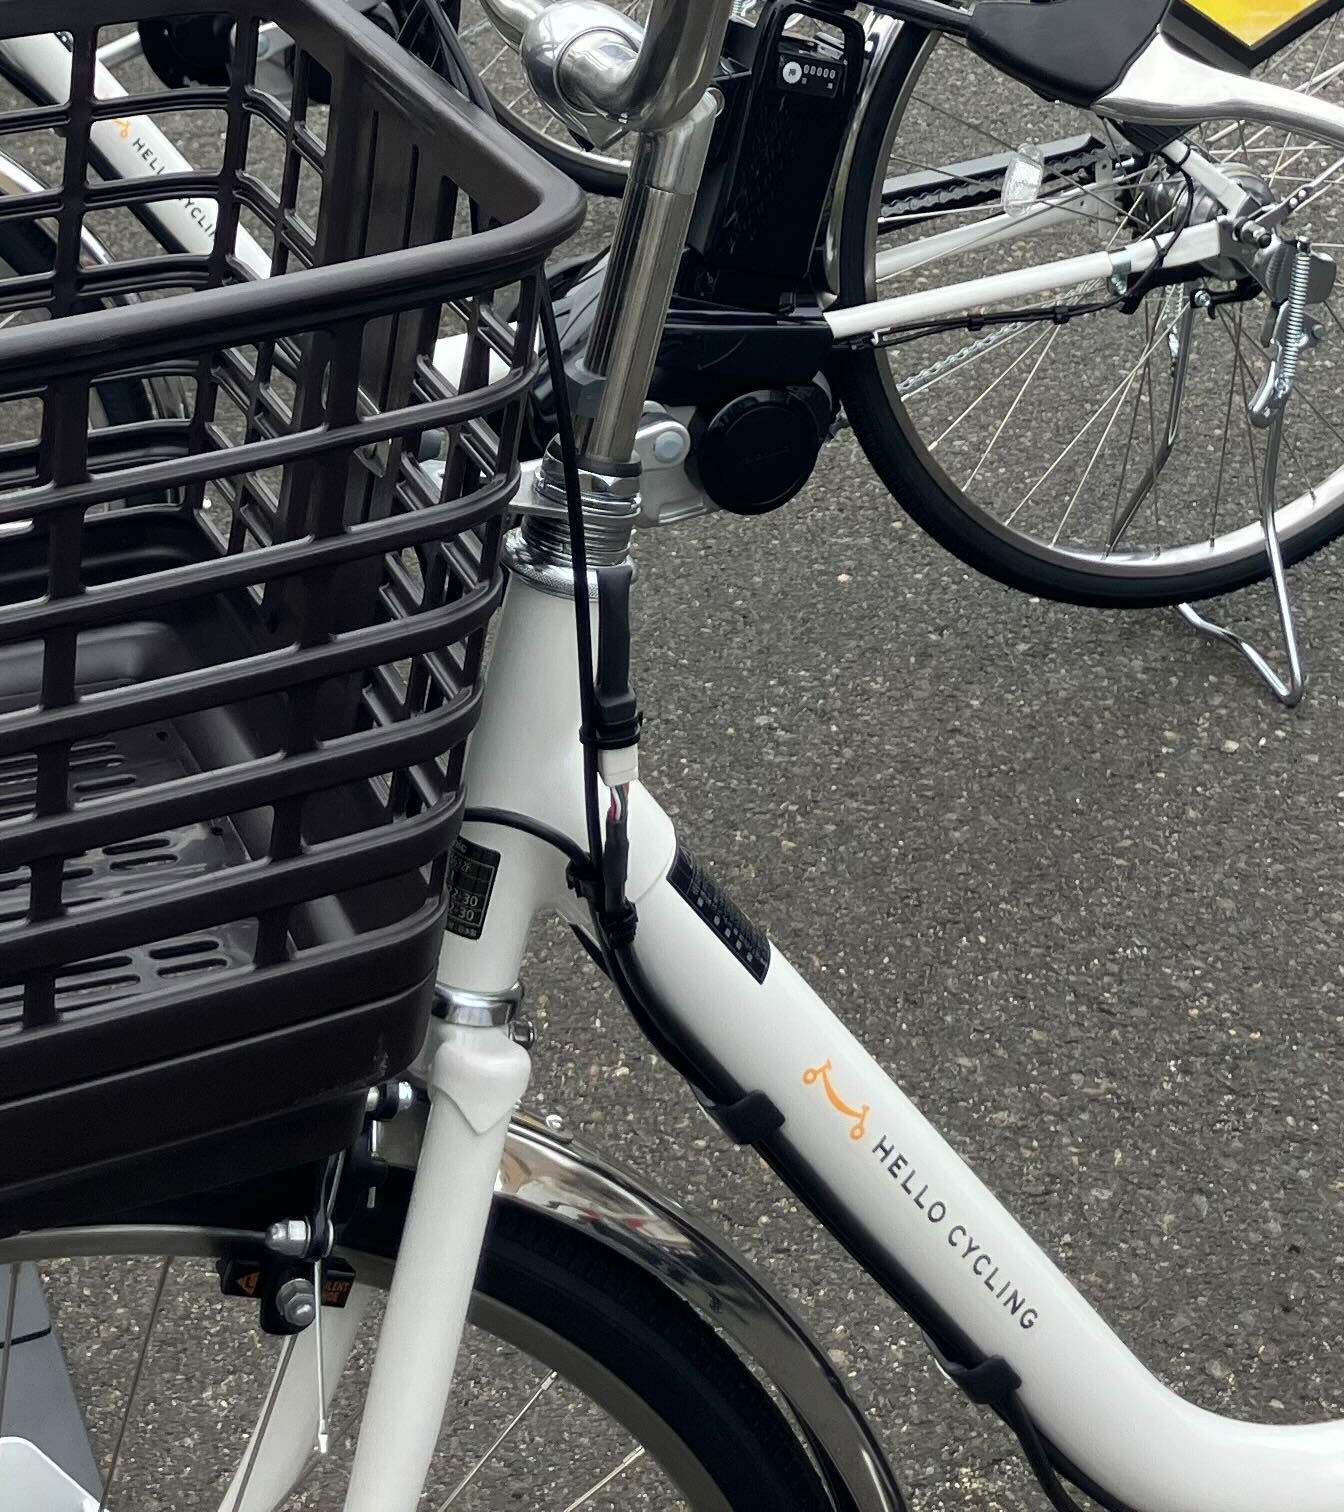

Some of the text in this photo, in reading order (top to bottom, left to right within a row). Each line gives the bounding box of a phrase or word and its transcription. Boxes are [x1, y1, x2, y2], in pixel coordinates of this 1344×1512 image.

[132, 137, 167, 177] HELL
[871, 1134, 1040, 1330] HELLO CYCLING
